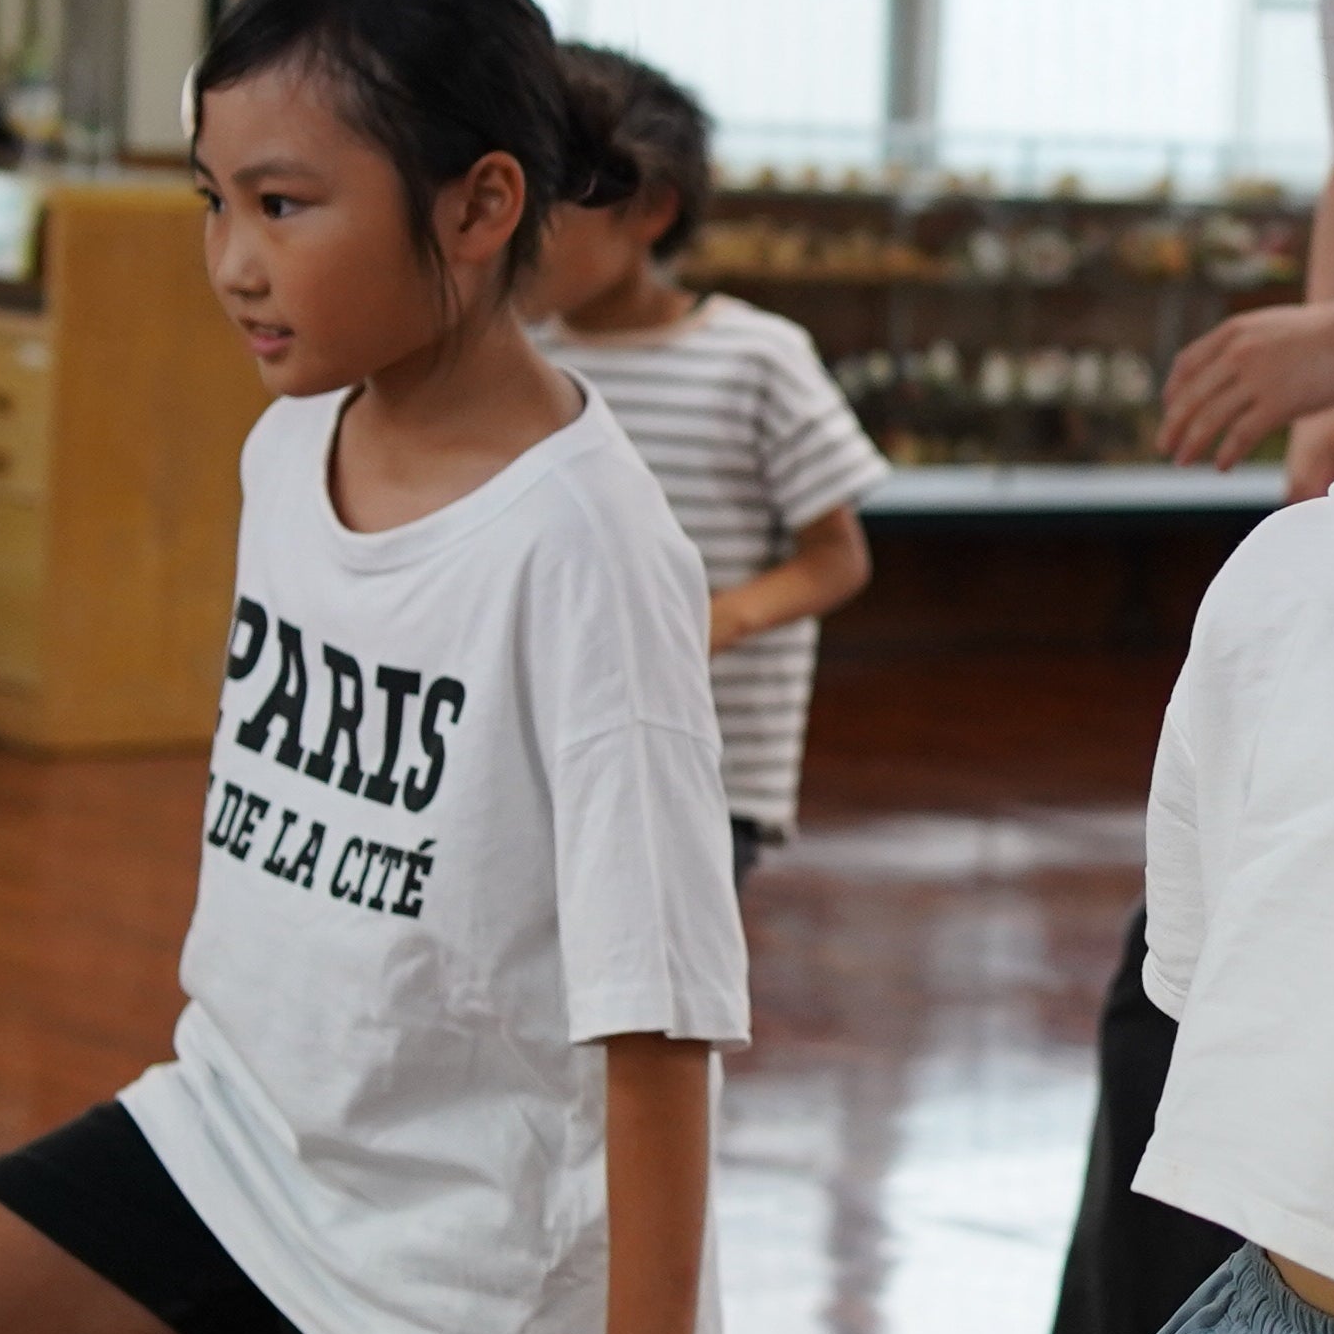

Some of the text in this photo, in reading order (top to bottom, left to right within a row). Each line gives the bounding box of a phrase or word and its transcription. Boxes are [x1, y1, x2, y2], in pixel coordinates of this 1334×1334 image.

[215, 595, 466, 813] PARIS
[207, 782, 438, 920] DE LA CITÉ
